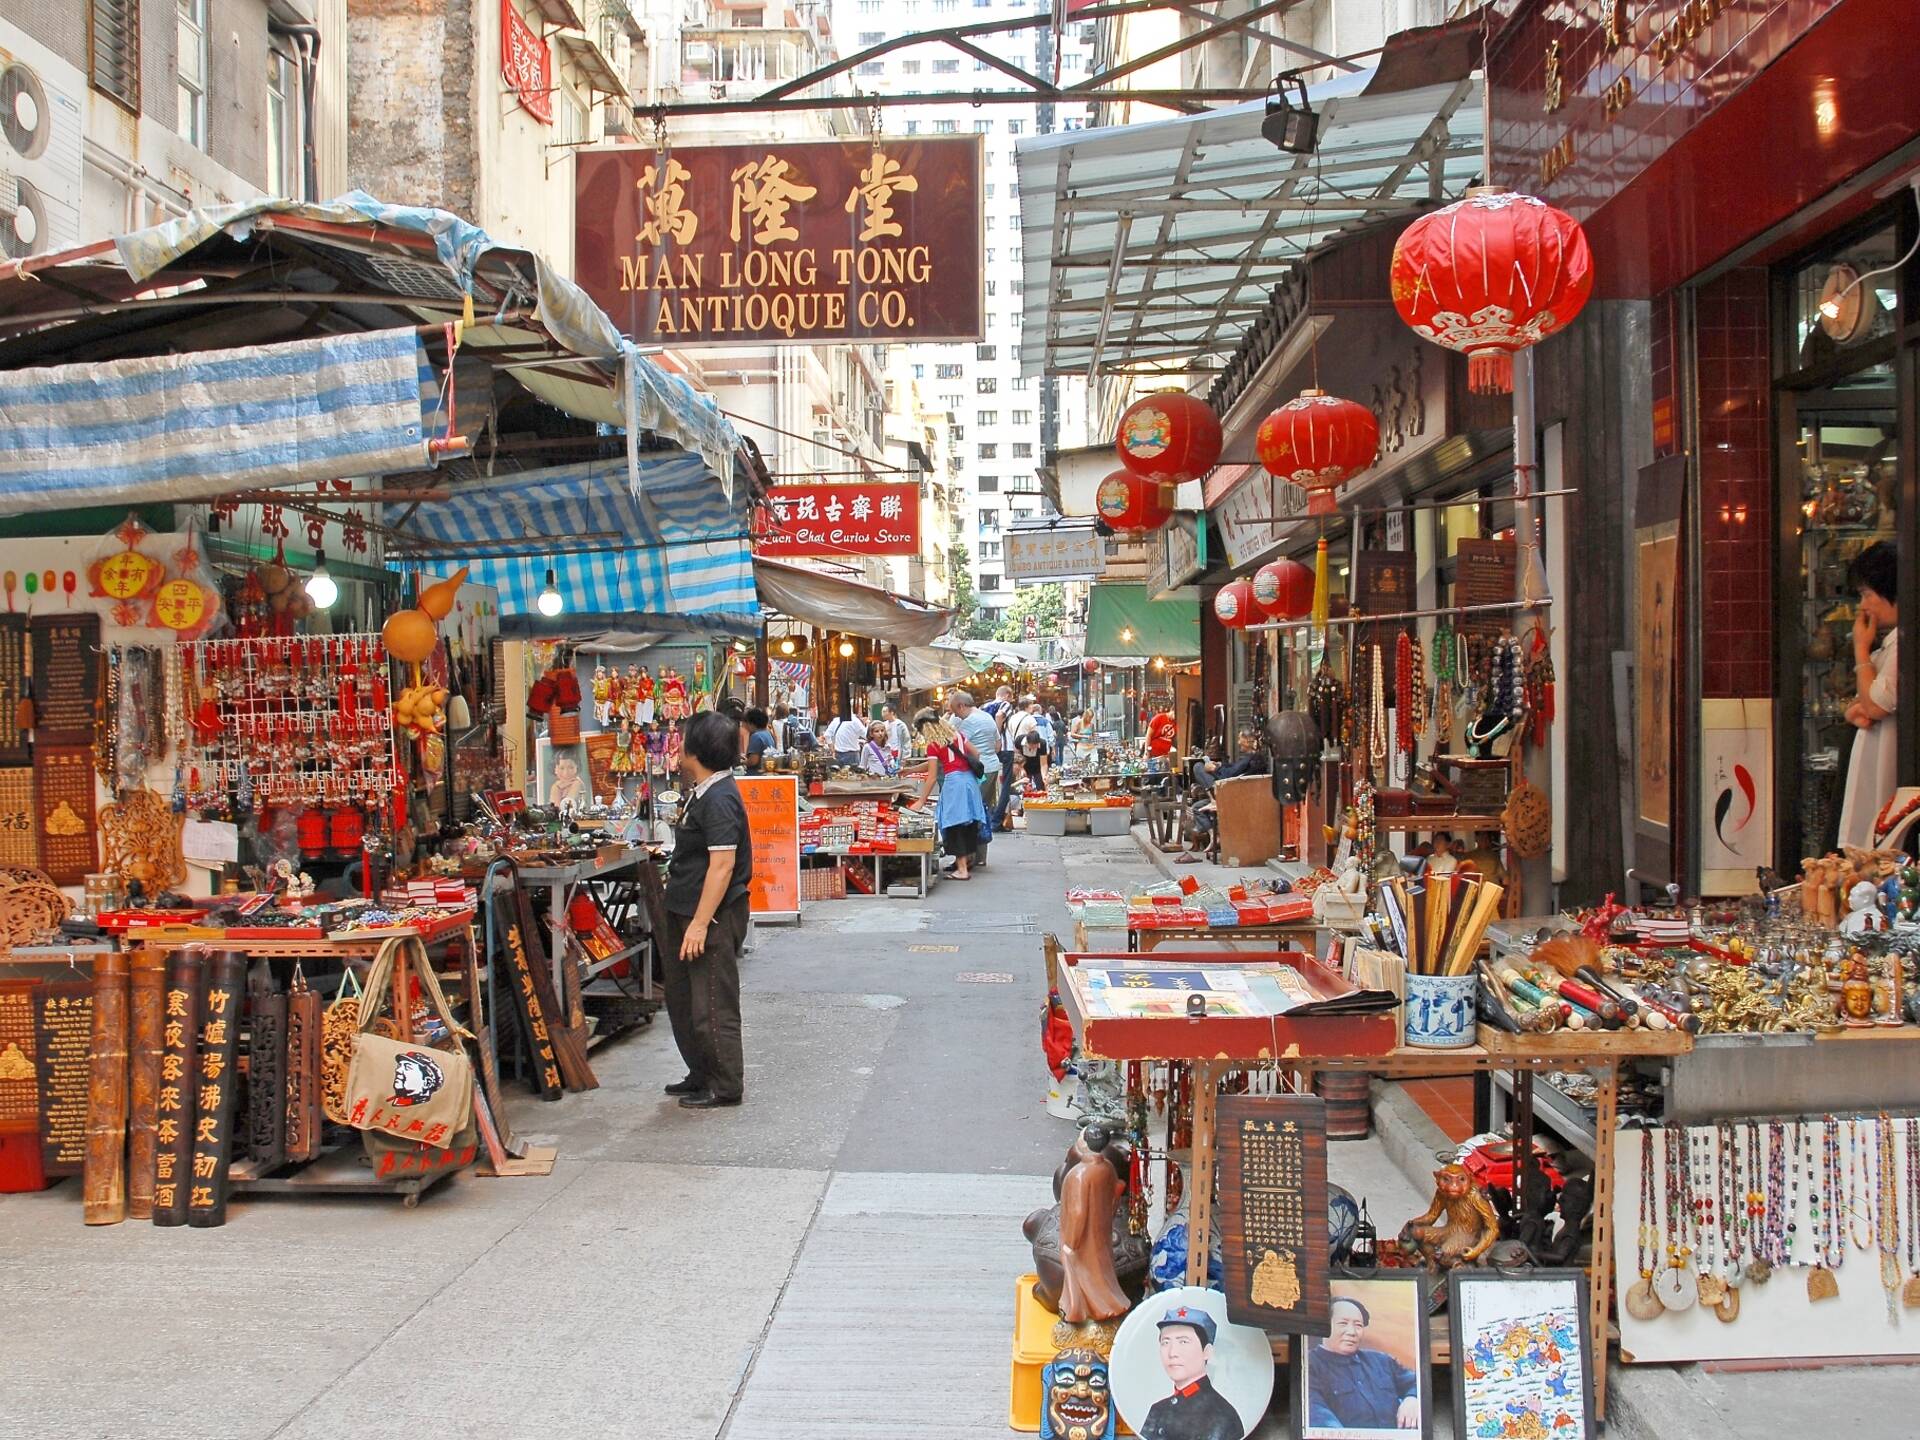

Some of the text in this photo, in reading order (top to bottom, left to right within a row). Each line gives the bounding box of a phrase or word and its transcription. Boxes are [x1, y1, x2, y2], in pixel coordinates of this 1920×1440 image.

[635, 154, 919, 246] 萬隆堂
[620, 245, 932, 292] MAN LONG TONG
[653, 290, 914, 338] ANTIOQUE CO.
[796, 528, 825, 544] Chai
[829, 529, 870, 544] Curios
[874, 529, 911, 544] Store
